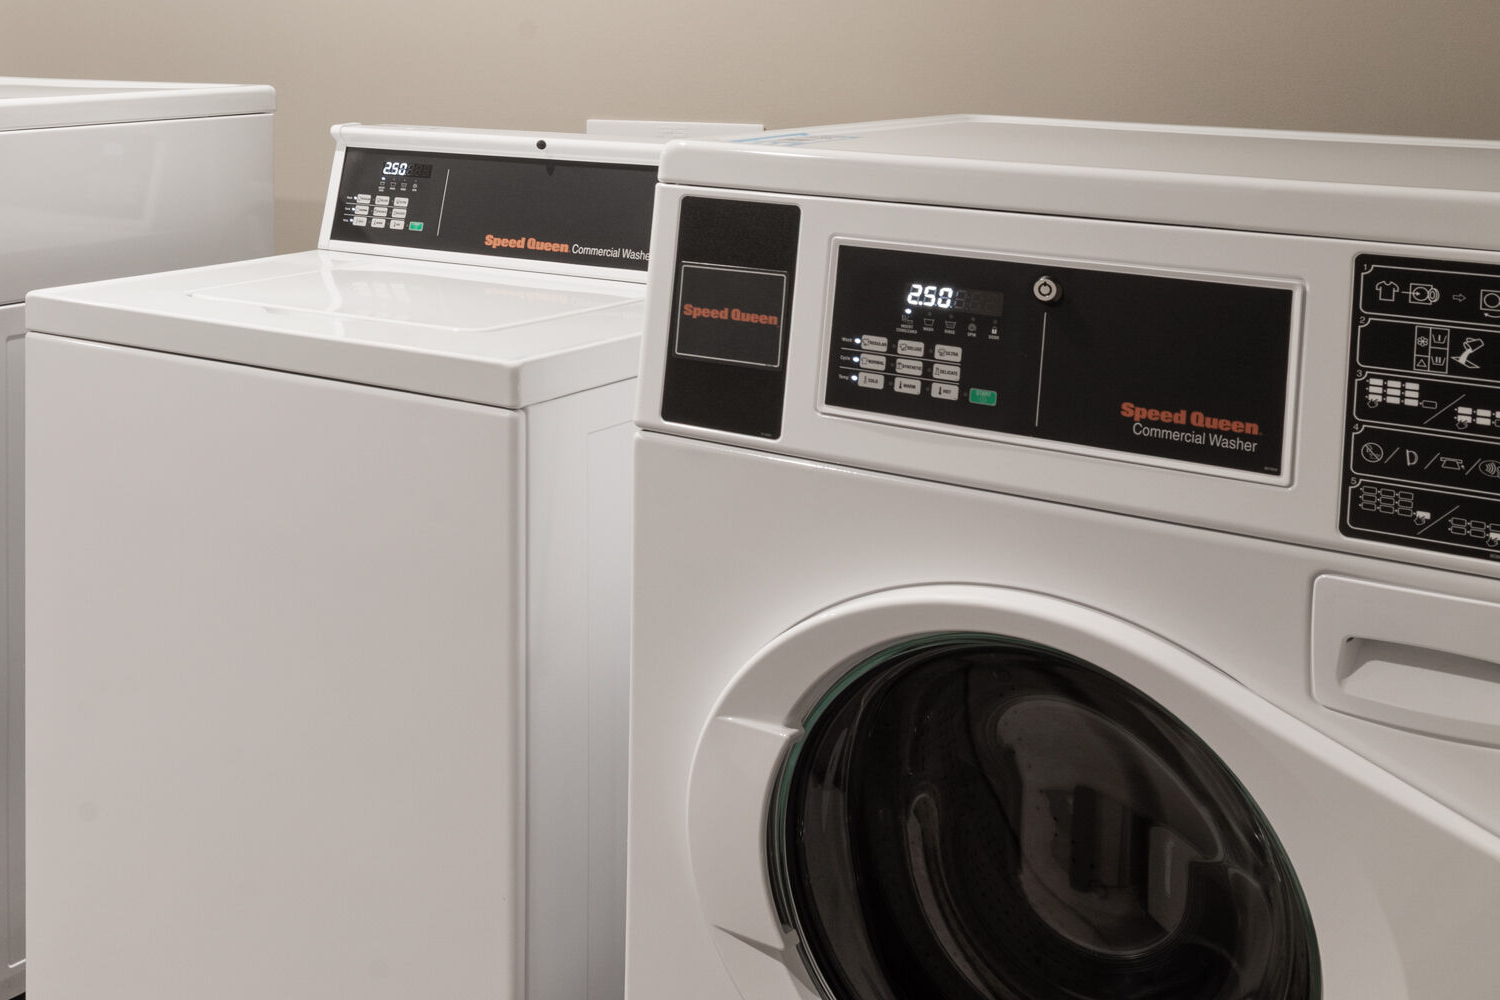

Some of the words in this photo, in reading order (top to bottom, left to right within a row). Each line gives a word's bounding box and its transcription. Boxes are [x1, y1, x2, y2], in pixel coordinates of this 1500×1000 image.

[485, 234, 525, 248] Speed
[527, 238, 569, 253] Queen
[572, 244, 620, 258] Commercial
[907, 284, 953, 309] 2.50
[684, 304, 728, 319] Speed
[731, 309, 778, 325] Queen
[1359, 316, 1366, 324] 2
[1356, 369, 1363, 377] 3
[1120, 401, 1187, 424] Speed
[1190, 411, 1260, 435] Queen
[1353, 423, 1359, 431] 4
[1132, 422, 1205, 445] Commercial
[1208, 432, 1258, 452] Washer
[1350, 477, 1357, 485] 5
